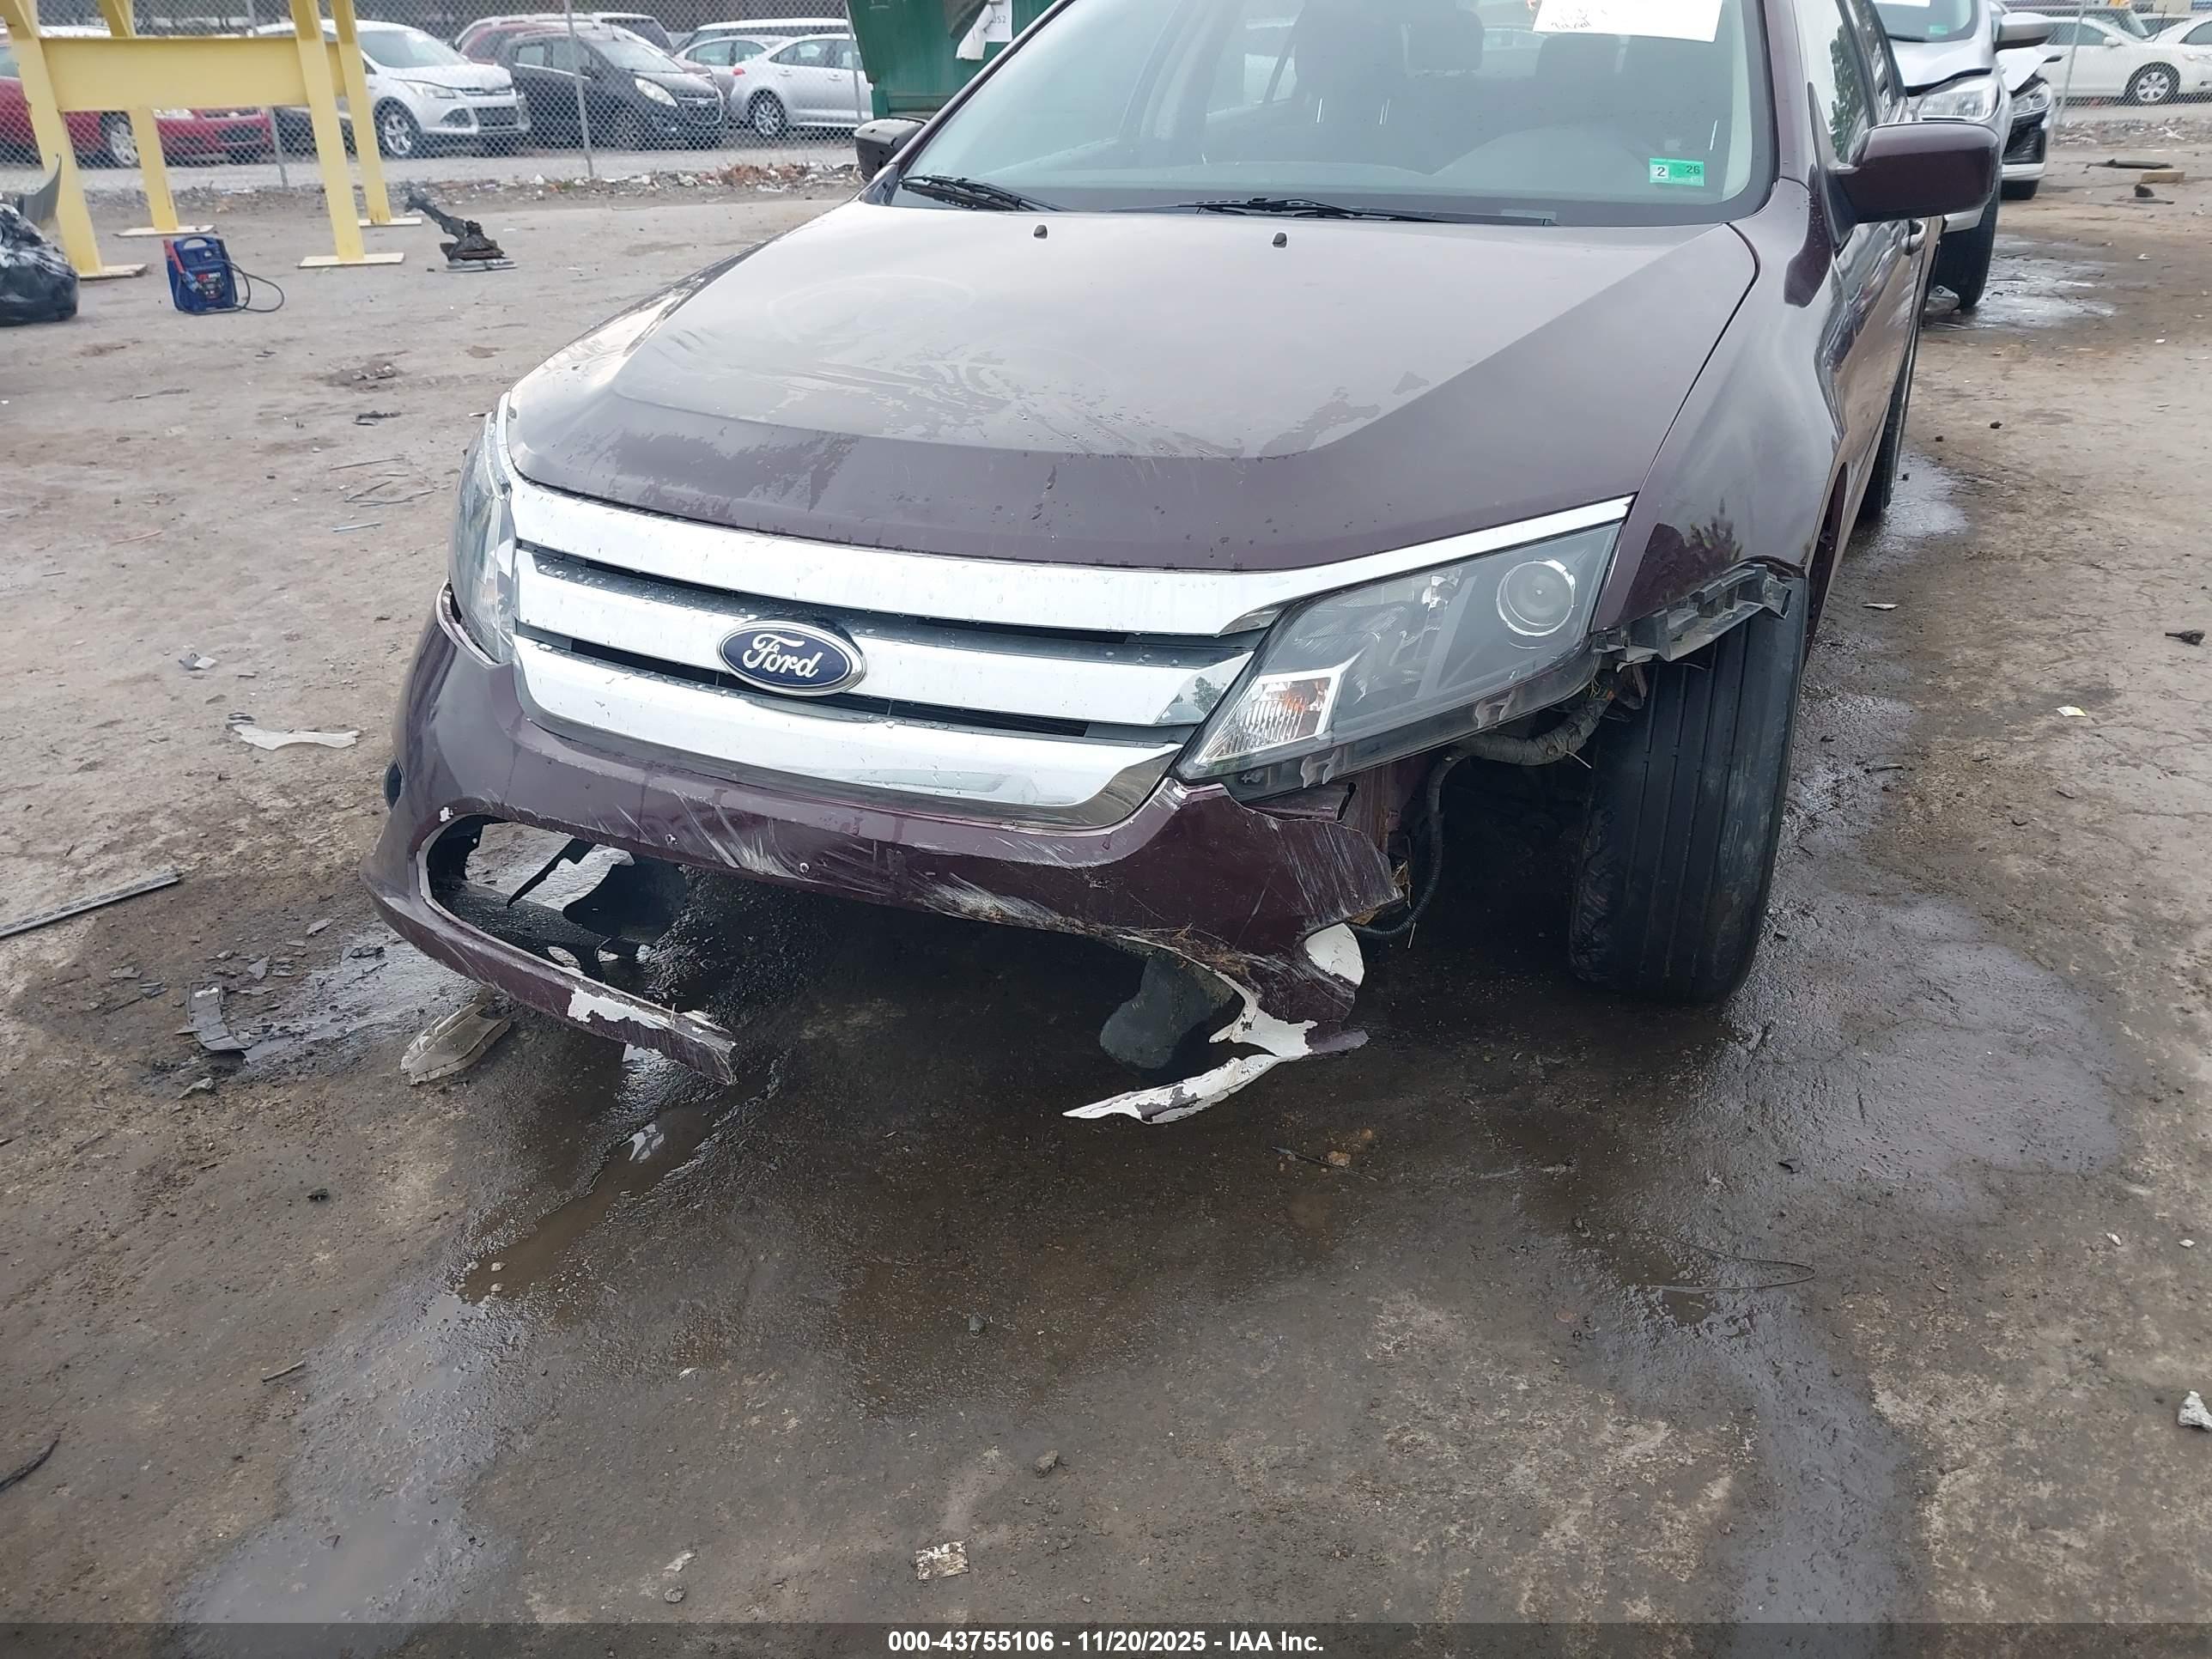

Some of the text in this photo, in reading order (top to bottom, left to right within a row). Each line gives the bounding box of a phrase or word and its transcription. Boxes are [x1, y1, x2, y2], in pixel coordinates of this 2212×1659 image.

[1656, 165, 1700, 178] 2 26
[742, 633, 823, 678] Ford
